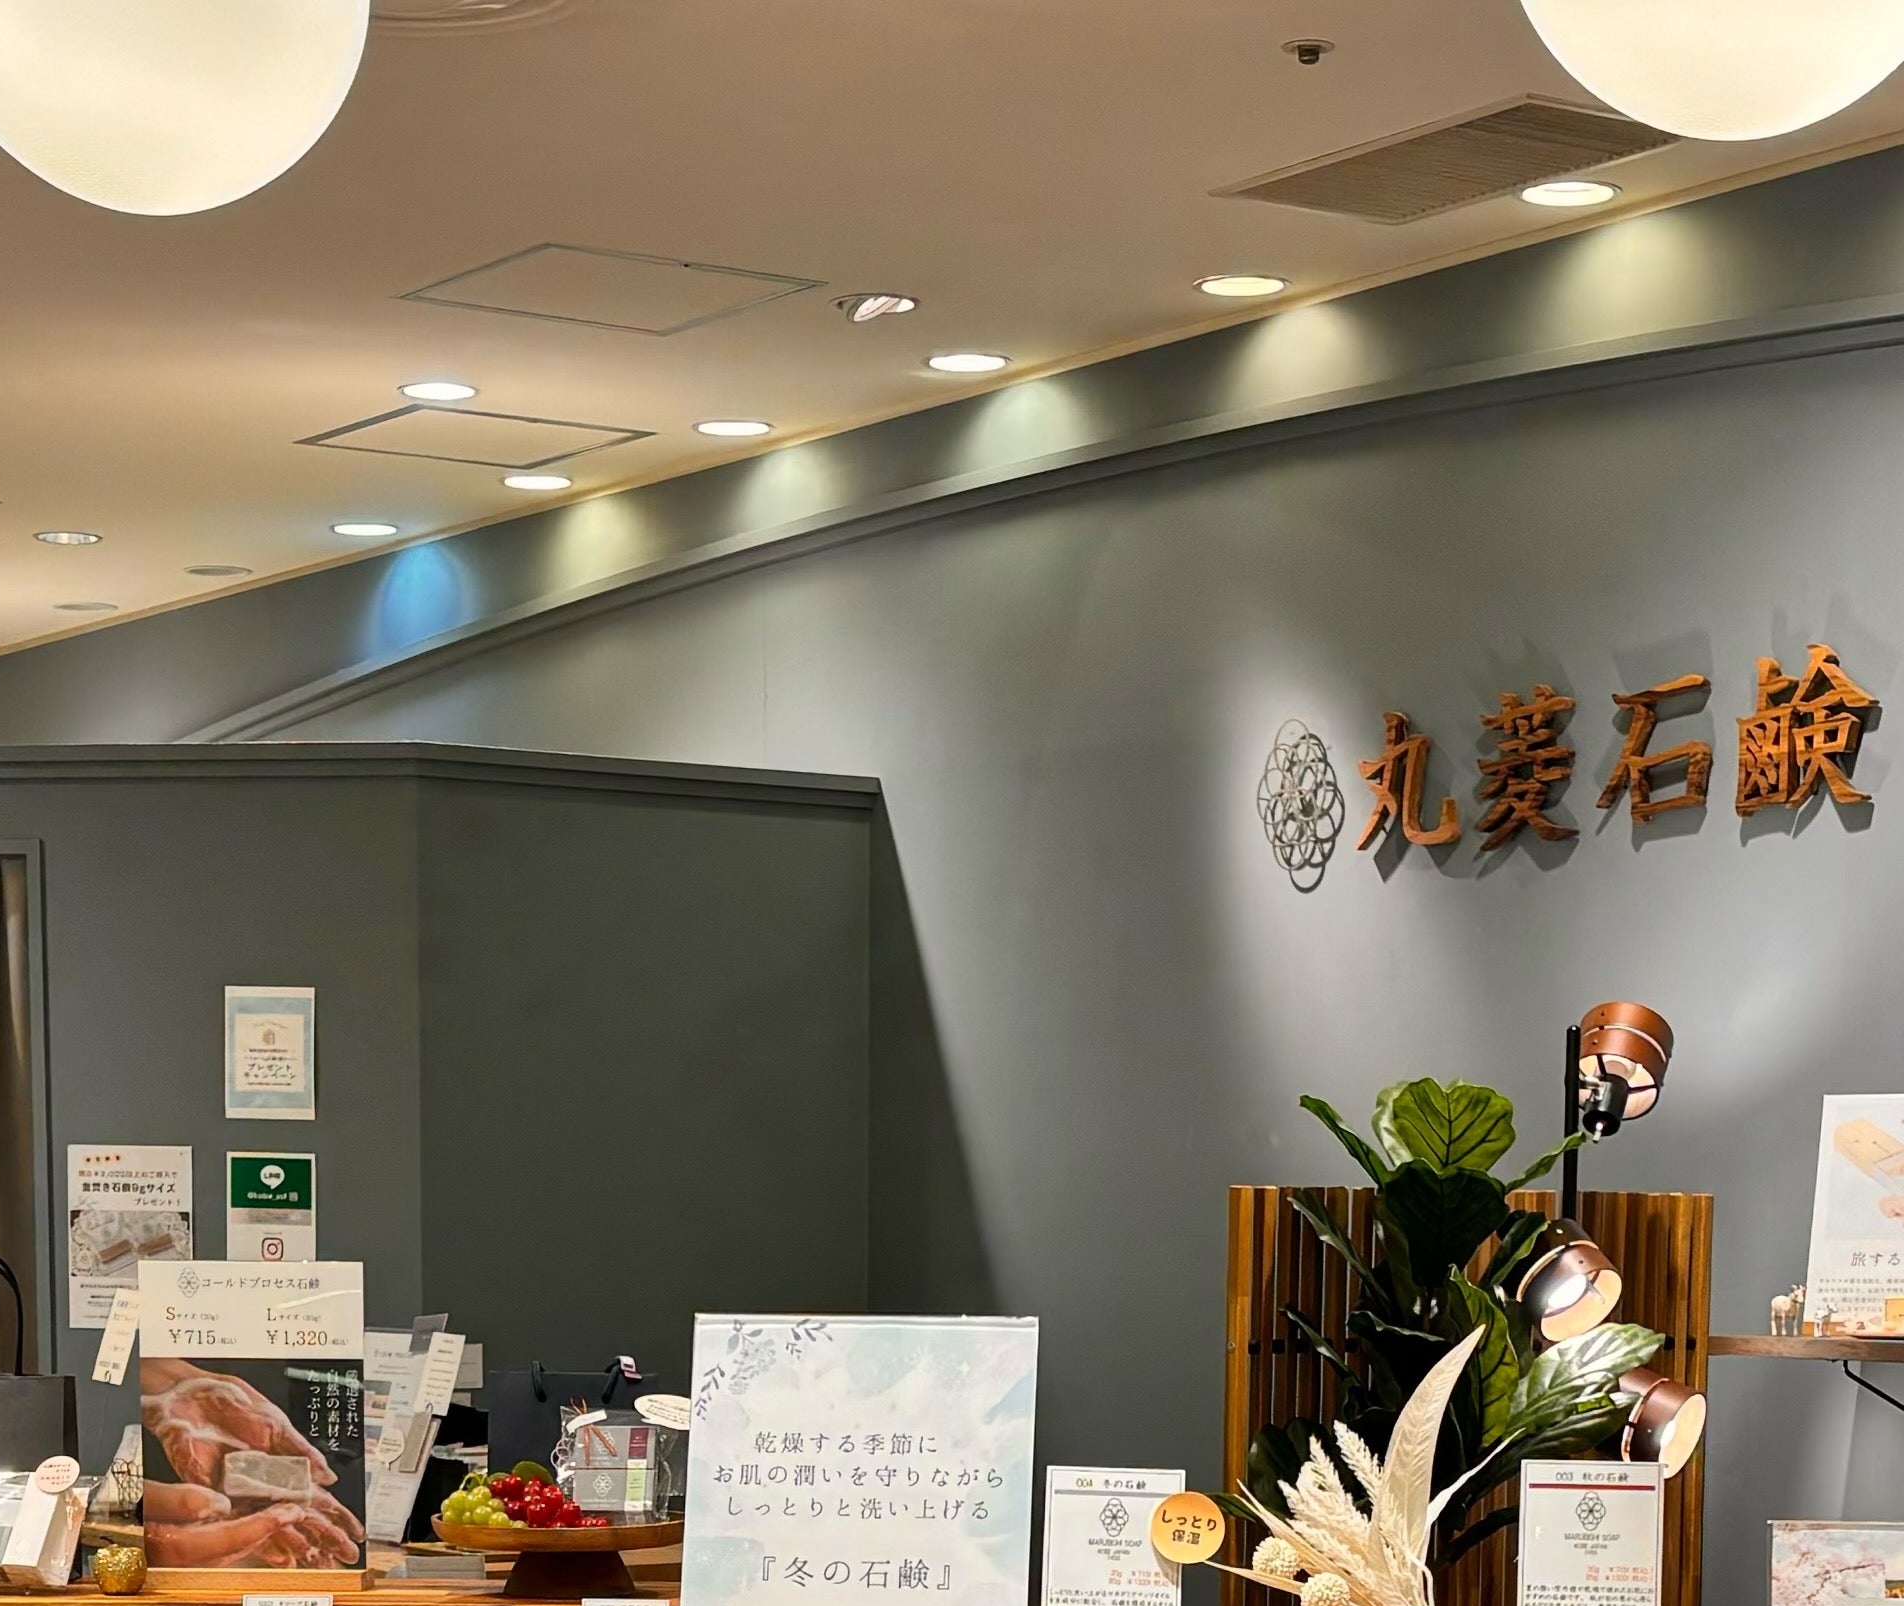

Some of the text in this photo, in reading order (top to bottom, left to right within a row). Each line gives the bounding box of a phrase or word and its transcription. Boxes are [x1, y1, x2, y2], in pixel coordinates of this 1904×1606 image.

[1355, 643, 1879, 852] 丸菱石鹸
[202, 1277, 320, 1290] コールドプロセス石鹸
[307, 1369, 321, 1437] たっぷりと
[753, 1431, 938, 1456] 乾燥する季節に
[713, 1464, 1006, 1488] お肌の潤いを守りながら
[1556, 1471, 1630, 1483] 003 秋の石鹸
[727, 1496, 991, 1522] しっとりと洗い上げる
[1161, 1509, 1217, 1531] しっとり
[761, 1556, 953, 1592] 『冬の石鹸』
